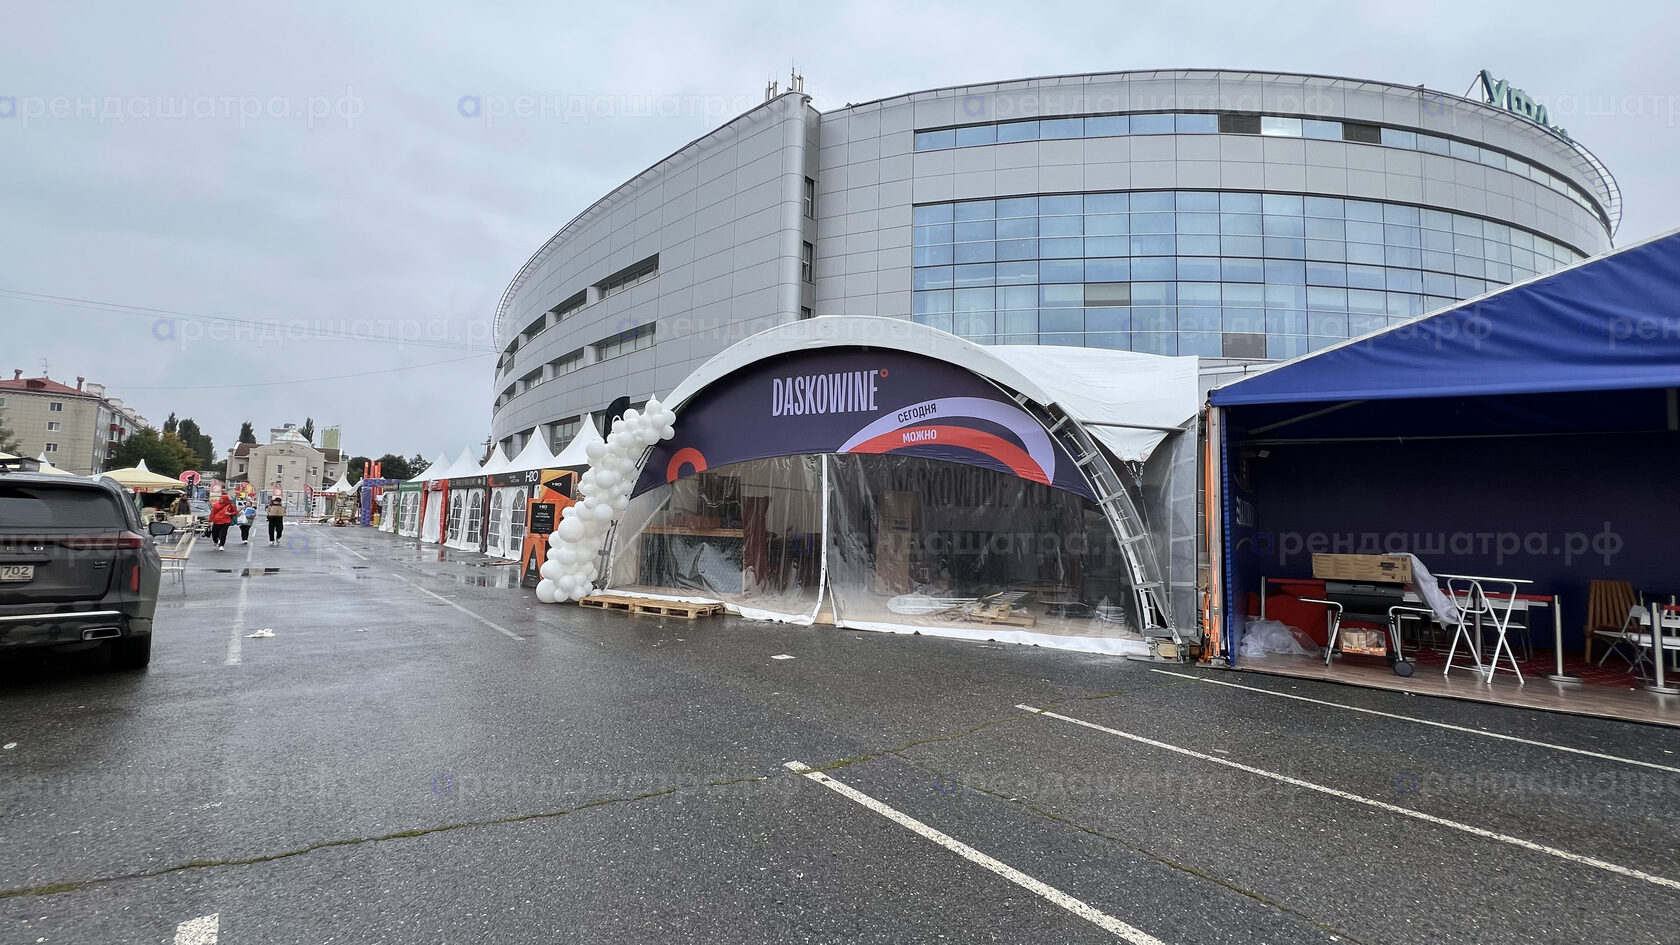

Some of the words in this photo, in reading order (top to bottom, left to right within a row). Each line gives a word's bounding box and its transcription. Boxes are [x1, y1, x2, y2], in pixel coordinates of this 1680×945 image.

[772, 369, 879, 417] DASKOWINE
[897, 403, 937, 423] СЕГОДНЯ
[902, 429, 937, 444] МОЖНО
[4, 566, 29, 576] 702
